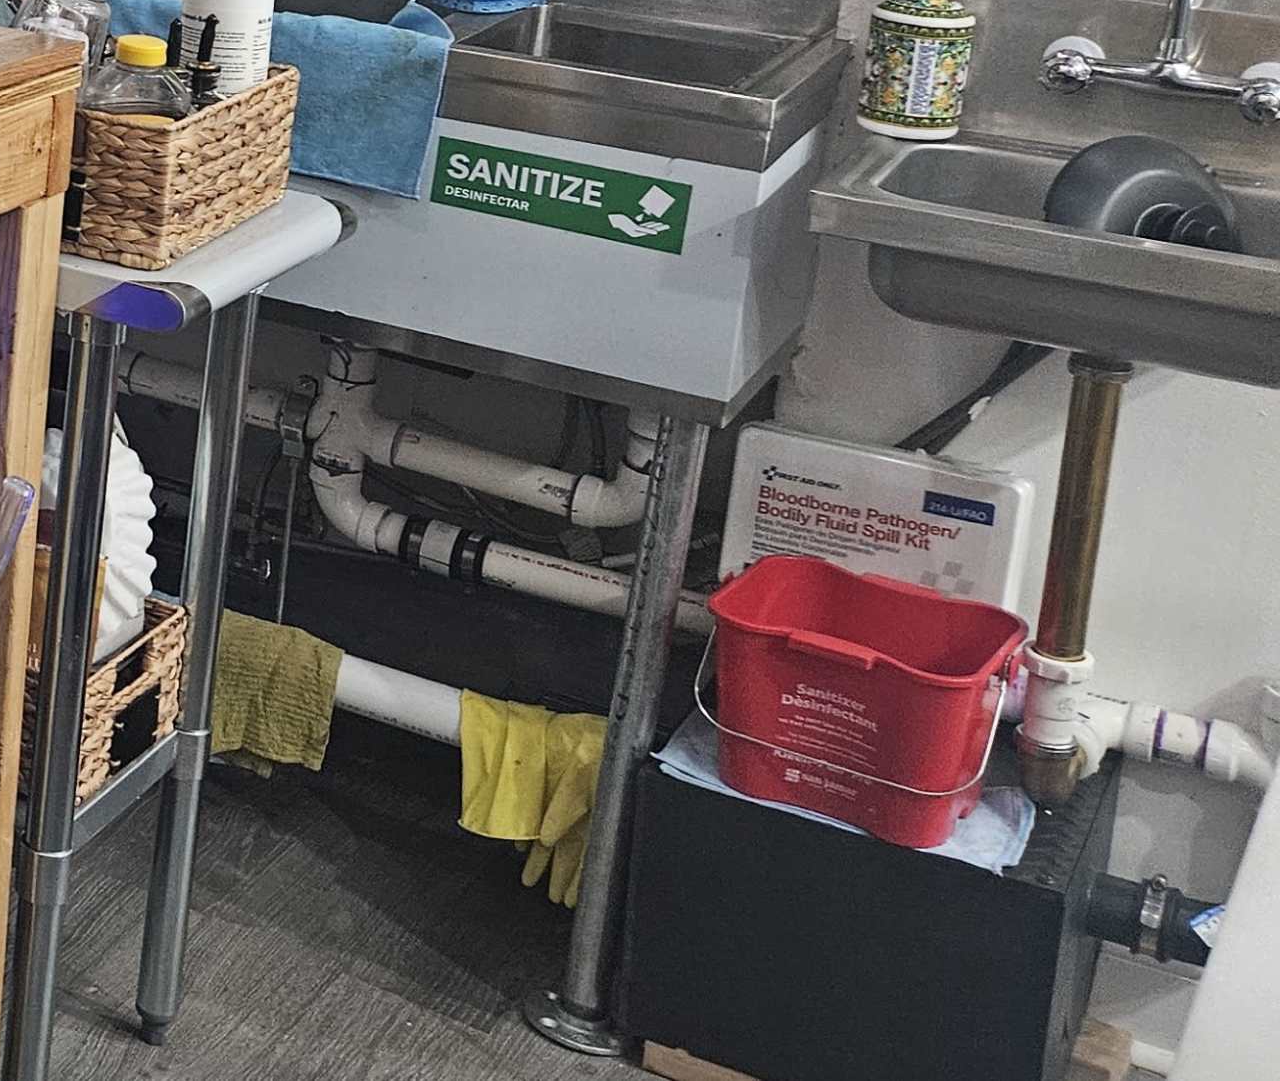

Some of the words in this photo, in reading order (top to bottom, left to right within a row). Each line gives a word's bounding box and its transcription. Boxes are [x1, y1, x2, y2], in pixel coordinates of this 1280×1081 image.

[444, 184, 530, 212] DESINFECTAR
[446, 152, 606, 208] SANITIZE
[757, 501, 810, 527] Bodily
[815, 514, 859, 536] Fluid
[862, 524, 901, 545] Spill
[905, 534, 931, 551] Kit
[759, 485, 861, 520] Bloodborne
[865, 509, 961, 540] Pathogen/
[796, 683, 866, 712] Sanitizer
